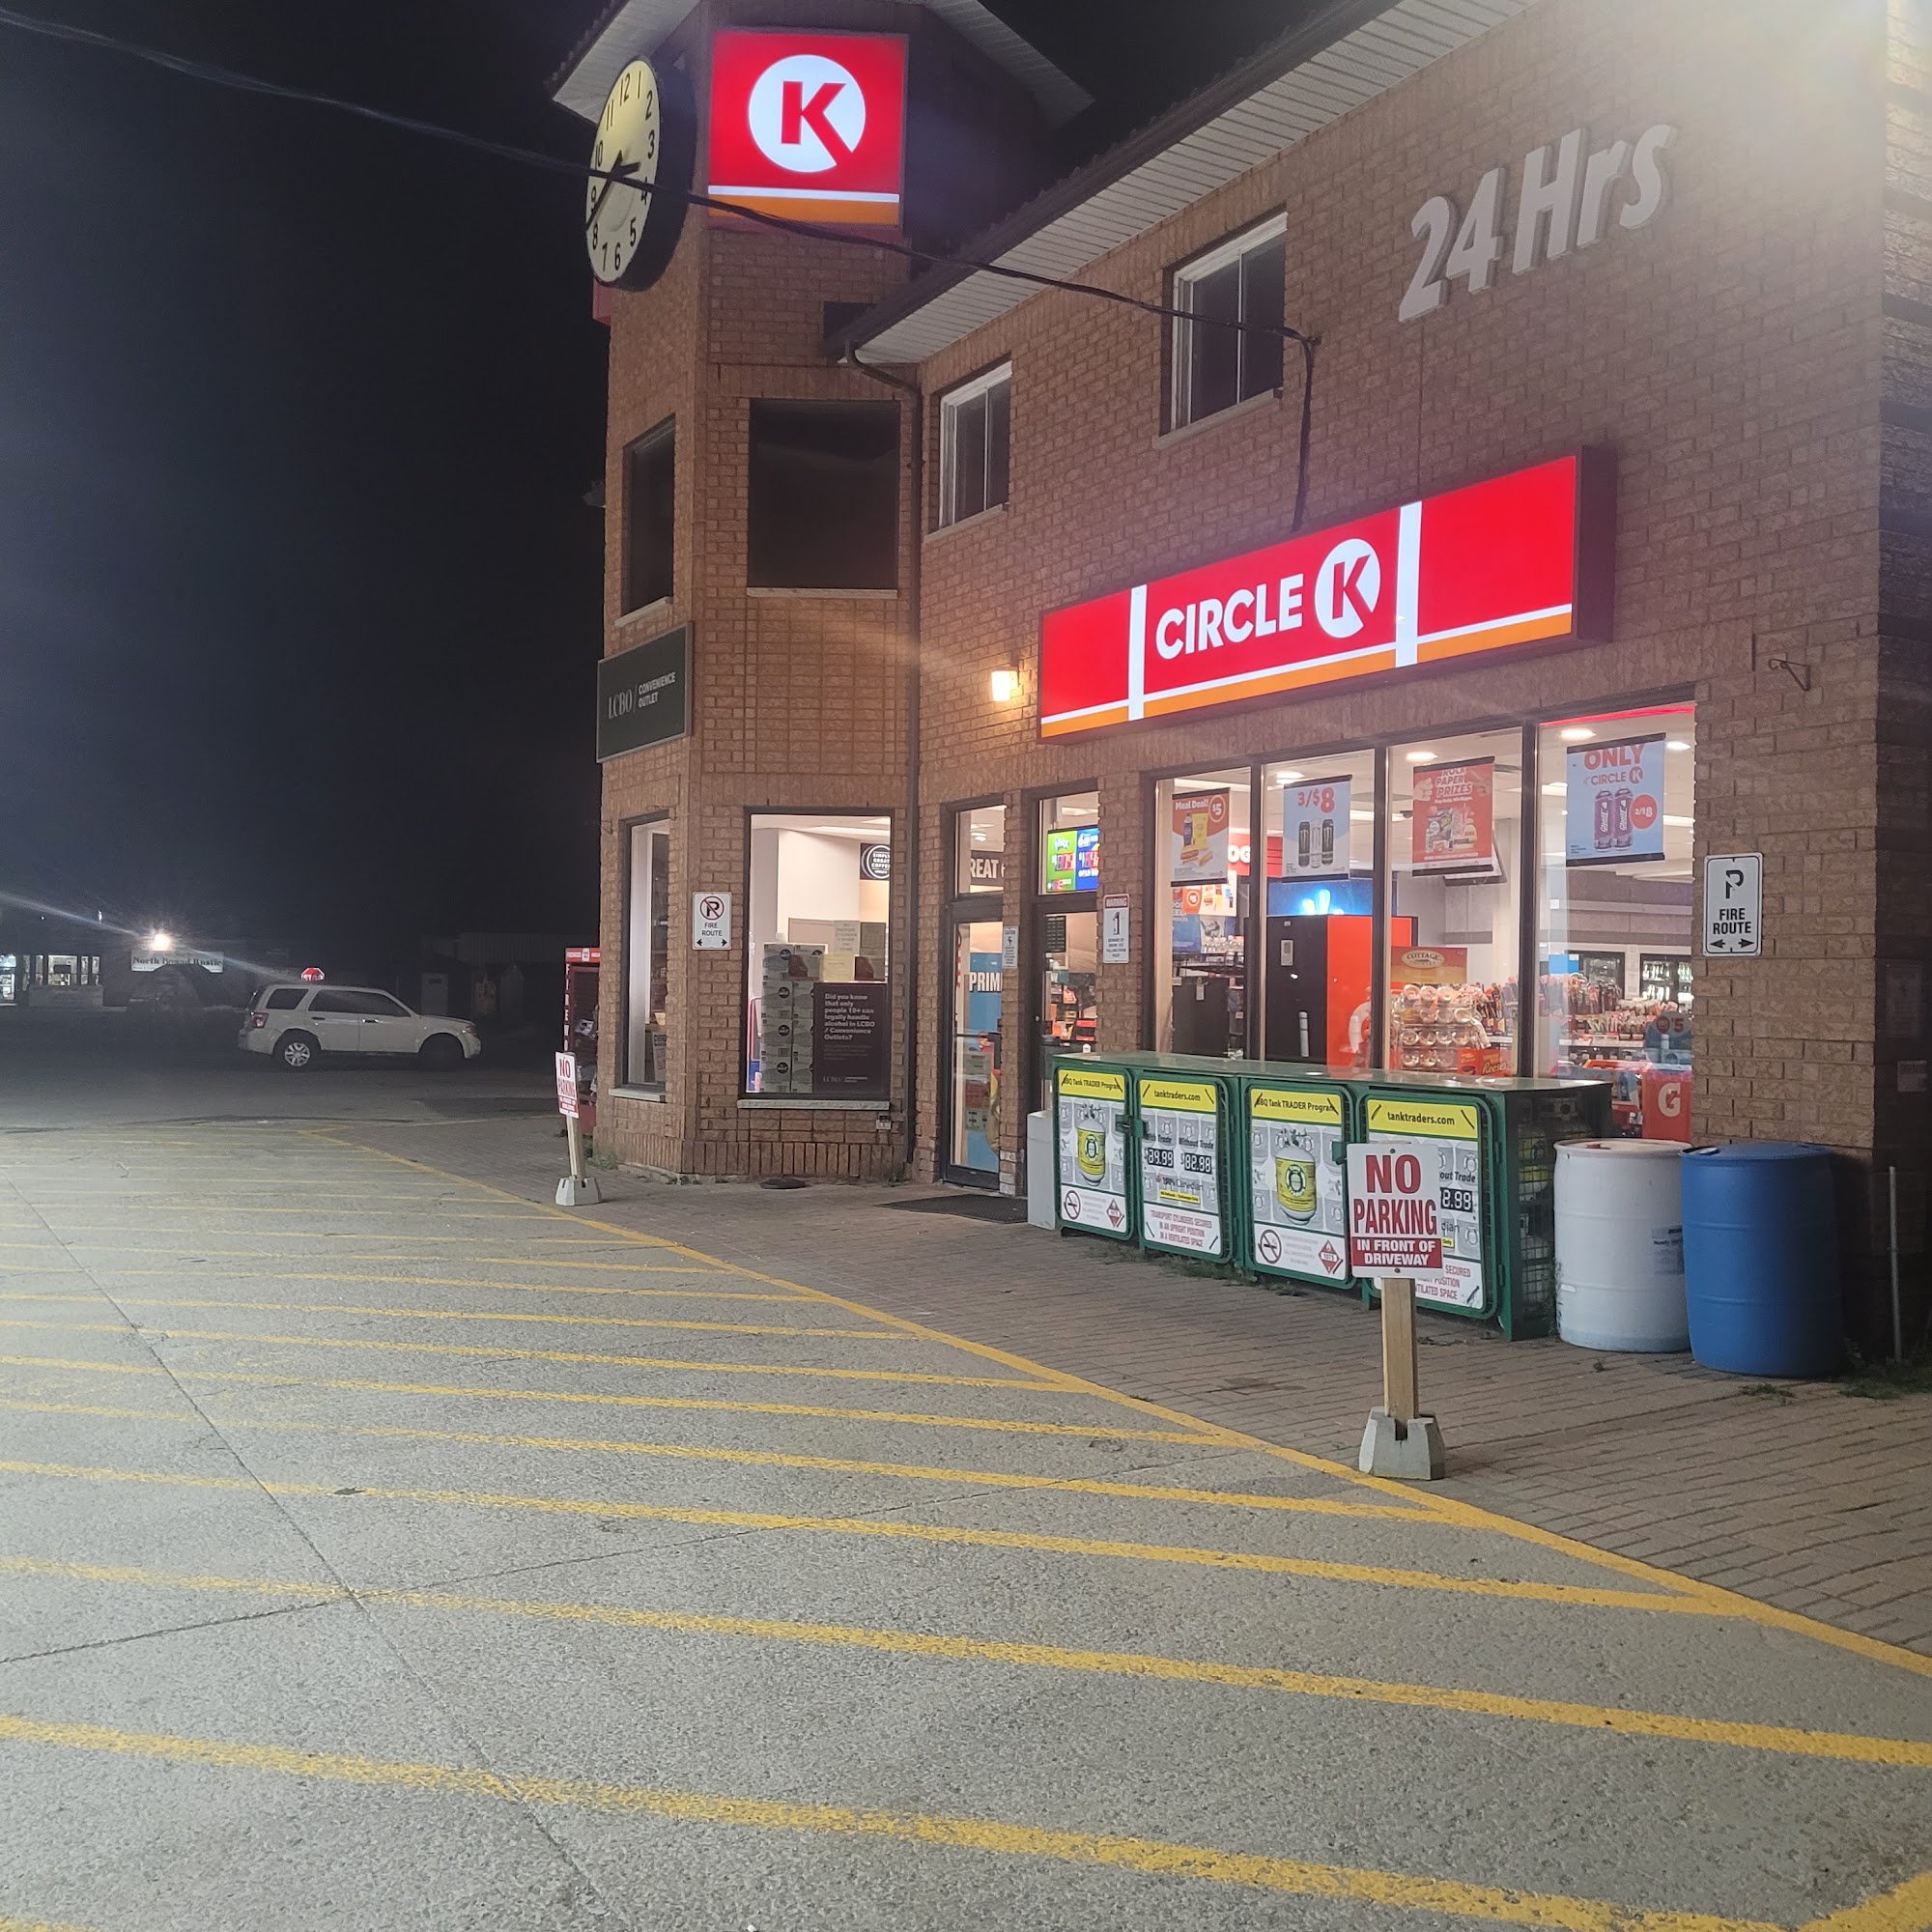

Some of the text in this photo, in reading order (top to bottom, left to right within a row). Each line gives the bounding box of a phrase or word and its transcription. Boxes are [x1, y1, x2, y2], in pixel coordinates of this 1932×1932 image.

[619, 72, 631, 106] 12
[606, 99, 614, 131] 11
[645, 90, 653, 121] 2
[647, 129, 655, 159] 3
[594, 139, 604, 171] 10
[630, 217, 637, 247] 5
[1399, 124, 1670, 323] 24 Hrs
[592, 222, 599, 250] 8
[602, 242, 608, 271] 7
[614, 242, 621, 270] 6
[1155, 573, 1304, 660] CIRCLE
[638, 671, 676, 695] CONVENIENCE
[608, 689, 633, 719] LCBO
[638, 692, 659, 708] OUTLET
[1584, 743, 1645, 771] ONLY
[1436, 775, 1463, 785] PAPER
[1591, 772, 1627, 785] CIRCLE
[1436, 783, 1472, 797] PRIZES
[1175, 799, 1209, 810] Meal Deal!
[1212, 803, 1222, 816] $5
[1298, 787, 1335, 813] 3/$8
[970, 859, 999, 878] REAT
[1719, 908, 1746, 921] FIRE
[1713, 922, 1751, 934] ROUTE
[559, 1058, 571, 1078] NO
[1083, 1079, 1100, 1088] TRADER
[1153, 1090, 1201, 1101] tanktraders.com
[1268, 1099, 1281, 1108] Tank
[1282, 1100, 1306, 1110] TRADER
[1387, 1112, 1455, 1125] tanktraders.com
[1365, 1154, 1421, 1194] NO
[1455, 1172, 1475, 1182] Trade
[1353, 1198, 1437, 1236] PARKING
[1356, 1239, 1435, 1252] IN FRONT OF
[1364, 1253, 1430, 1265] DRIVEWAY
[1445, 1264, 1470, 1277] SECURED
[1415, 1284, 1458, 1299] TILATED SPACE
